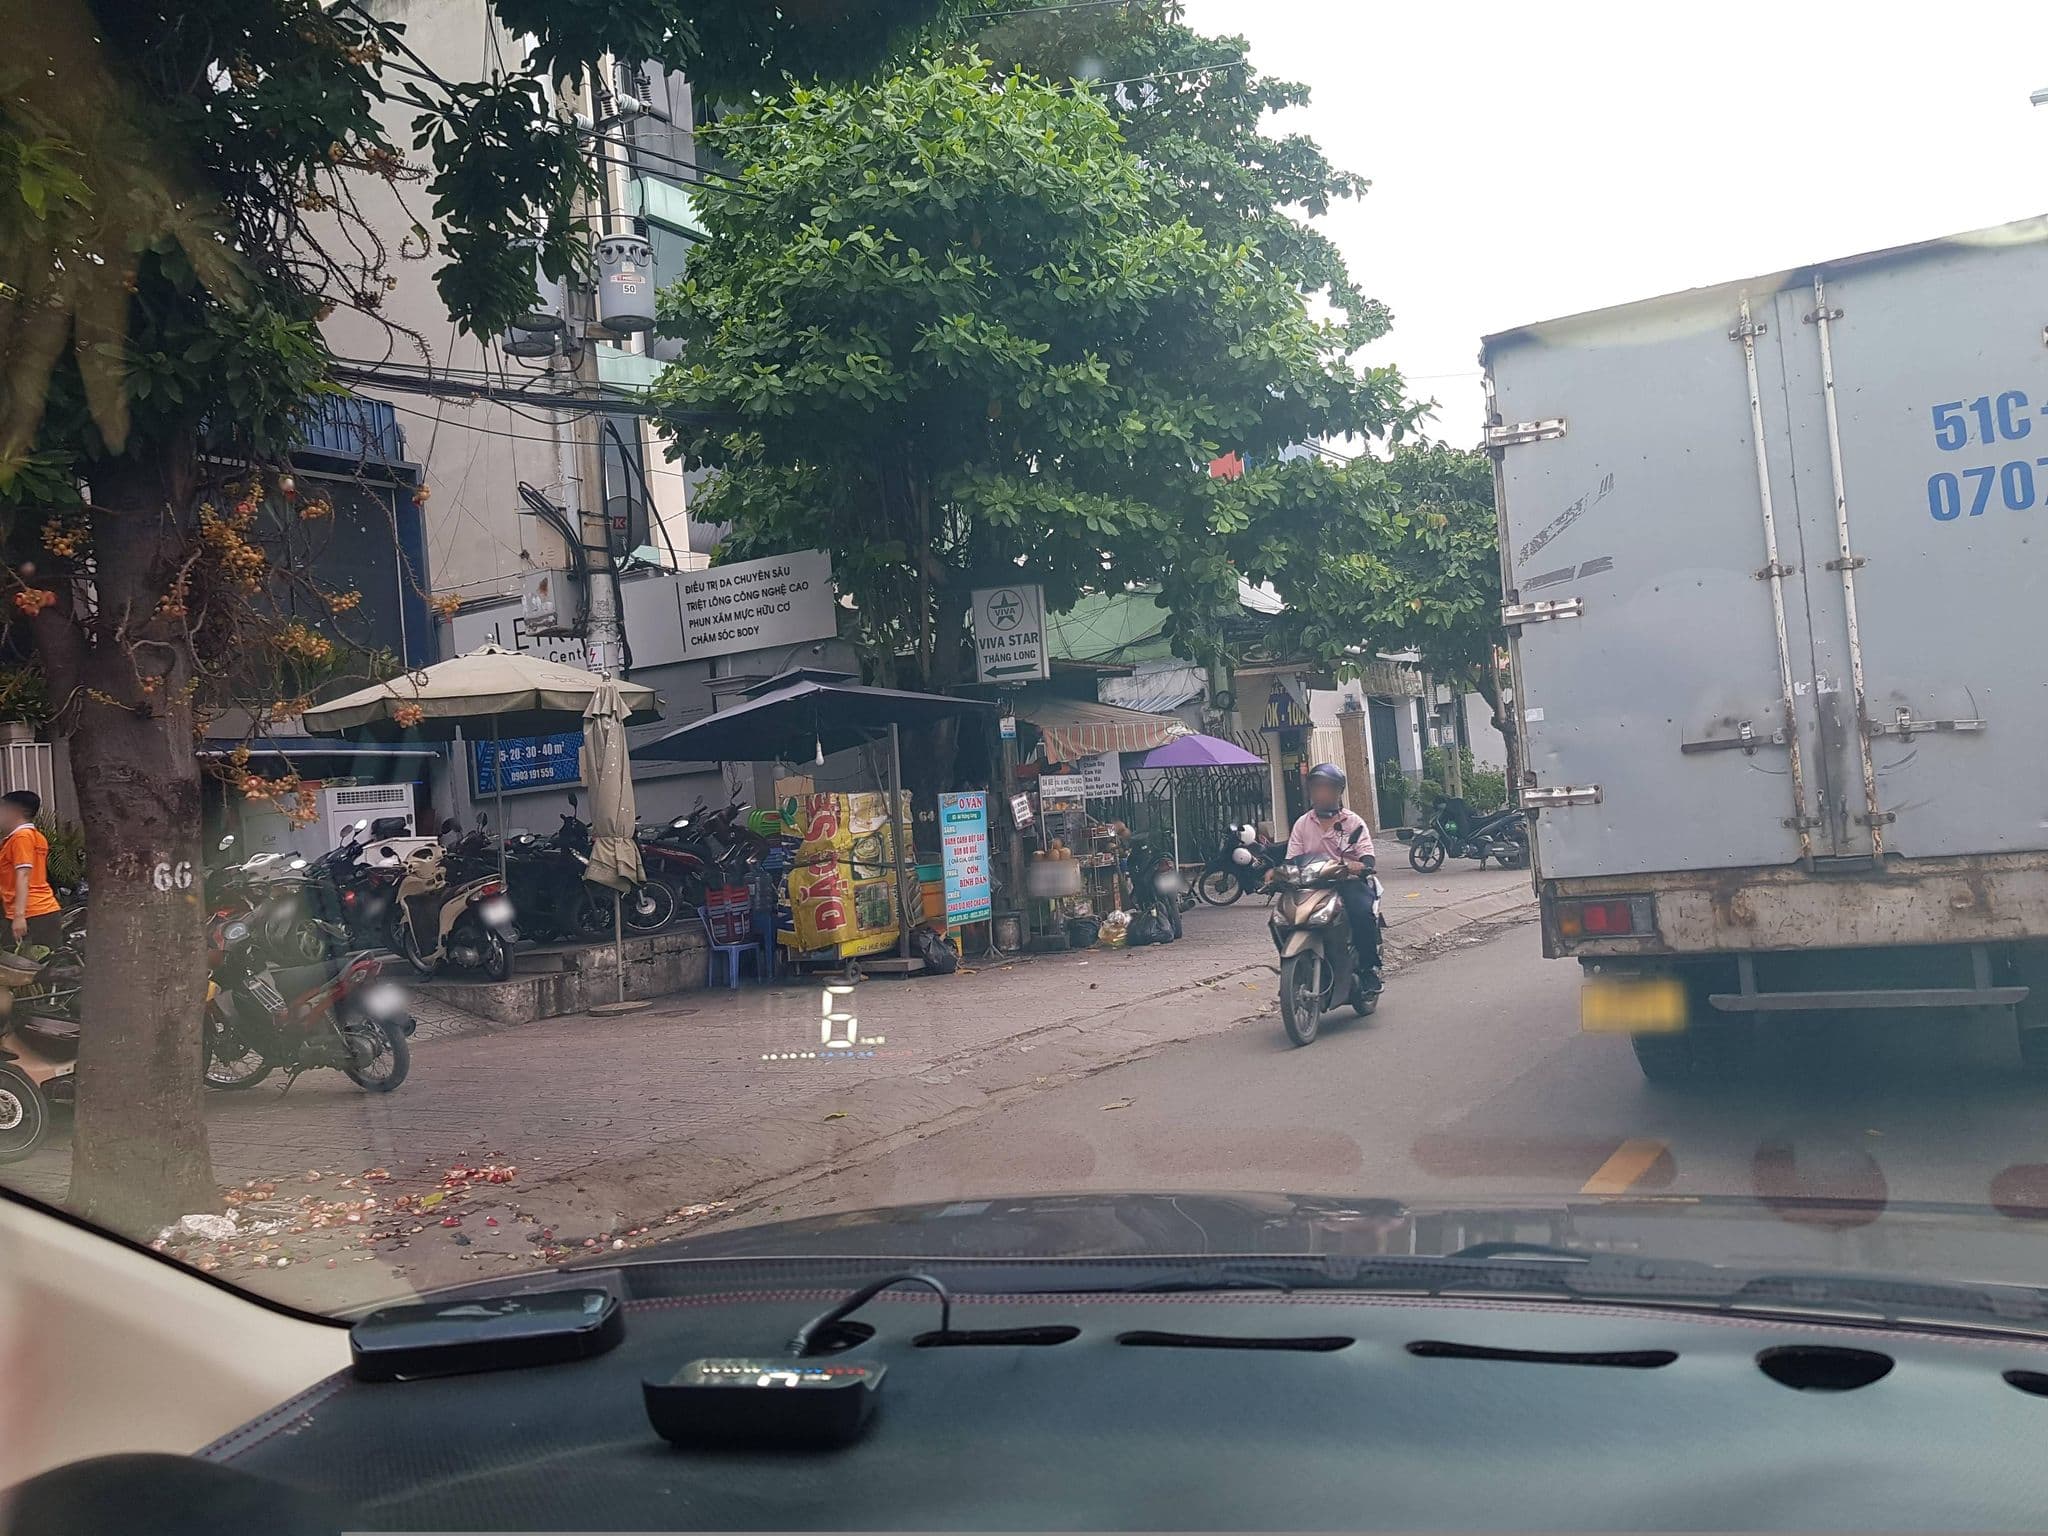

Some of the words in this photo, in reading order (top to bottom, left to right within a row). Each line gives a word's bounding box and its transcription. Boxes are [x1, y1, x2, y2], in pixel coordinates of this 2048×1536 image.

[623, 285, 635, 293] 50
[685, 581, 704, 594] ĐIỀU
[707, 580, 718, 590] TRỊ
[720, 579, 732, 588] DA
[734, 570, 770, 585] CHUYÊN
[773, 566, 791, 578] SÂU
[687, 599, 706, 611] TRIỆT
[709, 594, 731, 607] LÔNG
[734, 590, 759, 602] CÔNG
[762, 583, 787, 597] NGHỆ
[789, 581, 809, 593] CAO
[689, 616, 711, 629] PHUN
[713, 611, 732, 624] XĂM
[734, 608, 754, 620] MỰC
[756, 603, 775, 616] HỮU
[777, 601, 791, 612] CƠ
[995, 608, 1015, 616] VIVA
[691, 631, 716, 645] CHĂM
[718, 628, 735, 641] SÓC
[738, 626, 760, 637] BODY
[979, 636, 1005, 650] VIVA
[1009, 632, 1039, 647] STAR
[549, 649, 587, 663] Cent
[1014, 650, 1036, 661] LONG
[1263, 702, 1279, 728] 0K
[511, 748, 520, 760] 20
[526, 746, 537, 758] 30
[542, 743, 553, 755] 40
[919, 811, 935, 822] 64
[154, 861, 192, 891] 66
[822, 986, 858, 1048] 6
